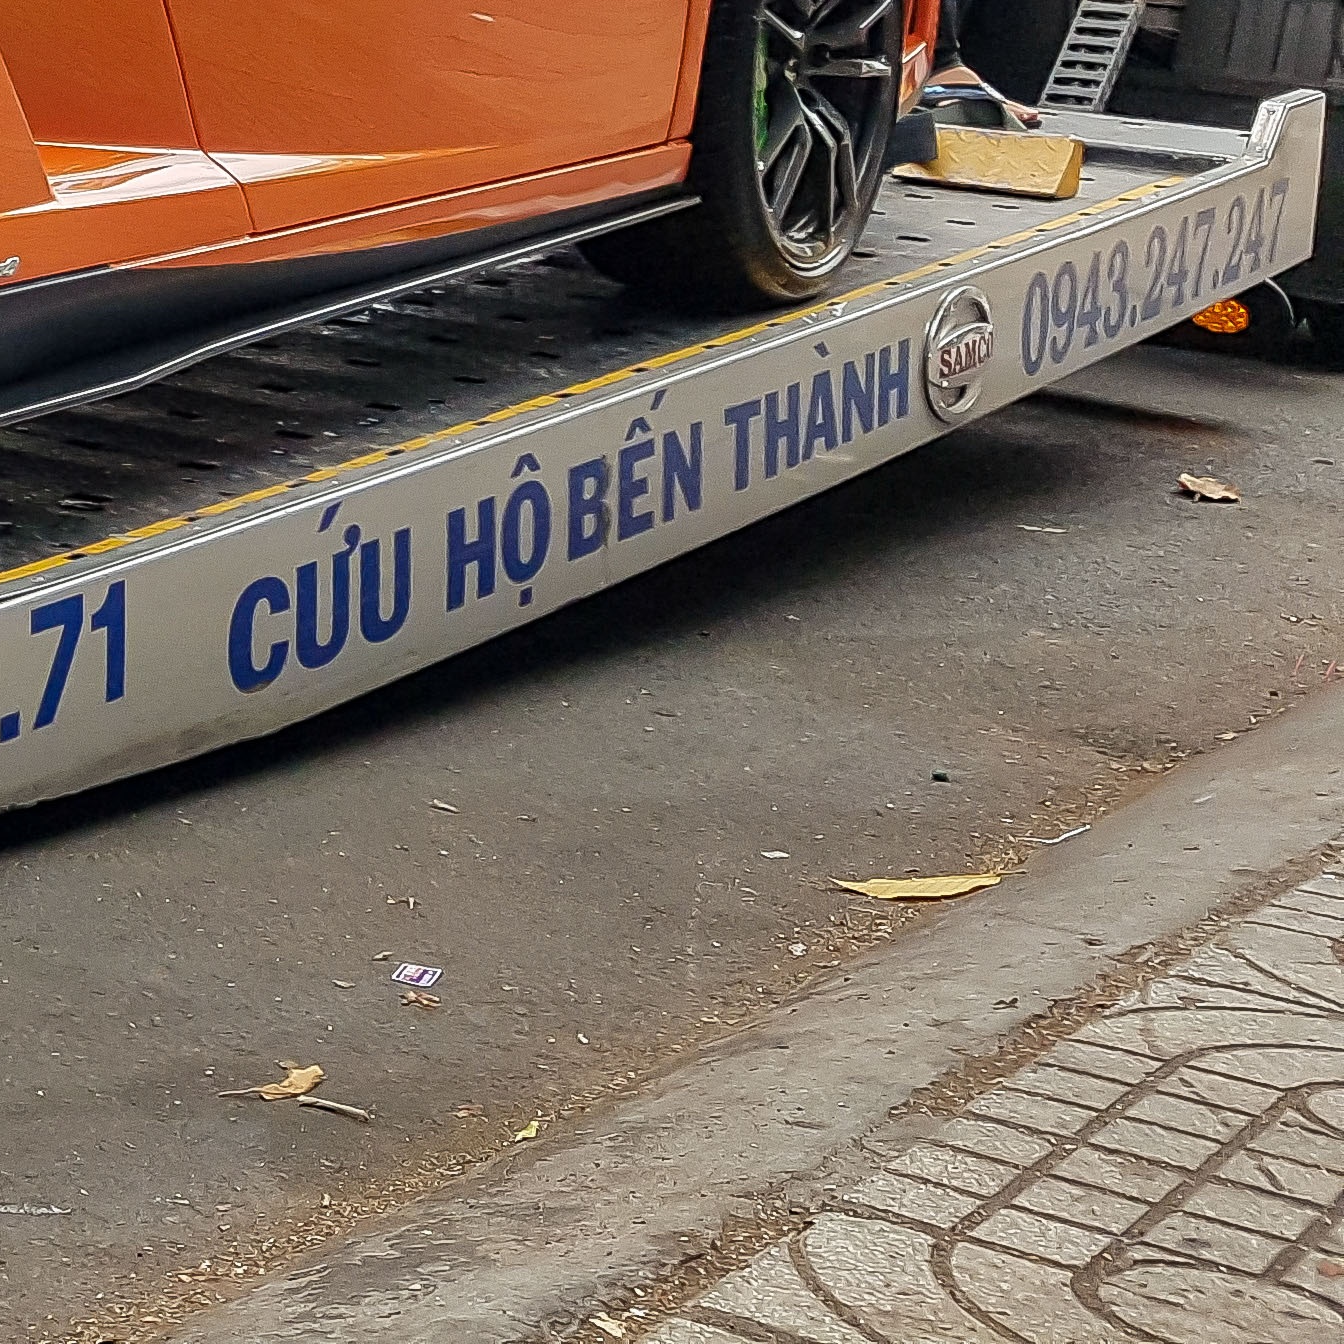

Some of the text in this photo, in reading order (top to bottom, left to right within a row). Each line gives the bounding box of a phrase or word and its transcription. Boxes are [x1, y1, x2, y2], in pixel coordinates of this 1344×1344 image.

[939, 332, 993, 379] SAMCO
[1020, 177, 1291, 377] 0943.247.247
[228, 501, 411, 695] CỨU
[445, 452, 551, 607] HỘ
[566, 389, 703, 562] BẾN
[723, 340, 912, 492] THÀNH
